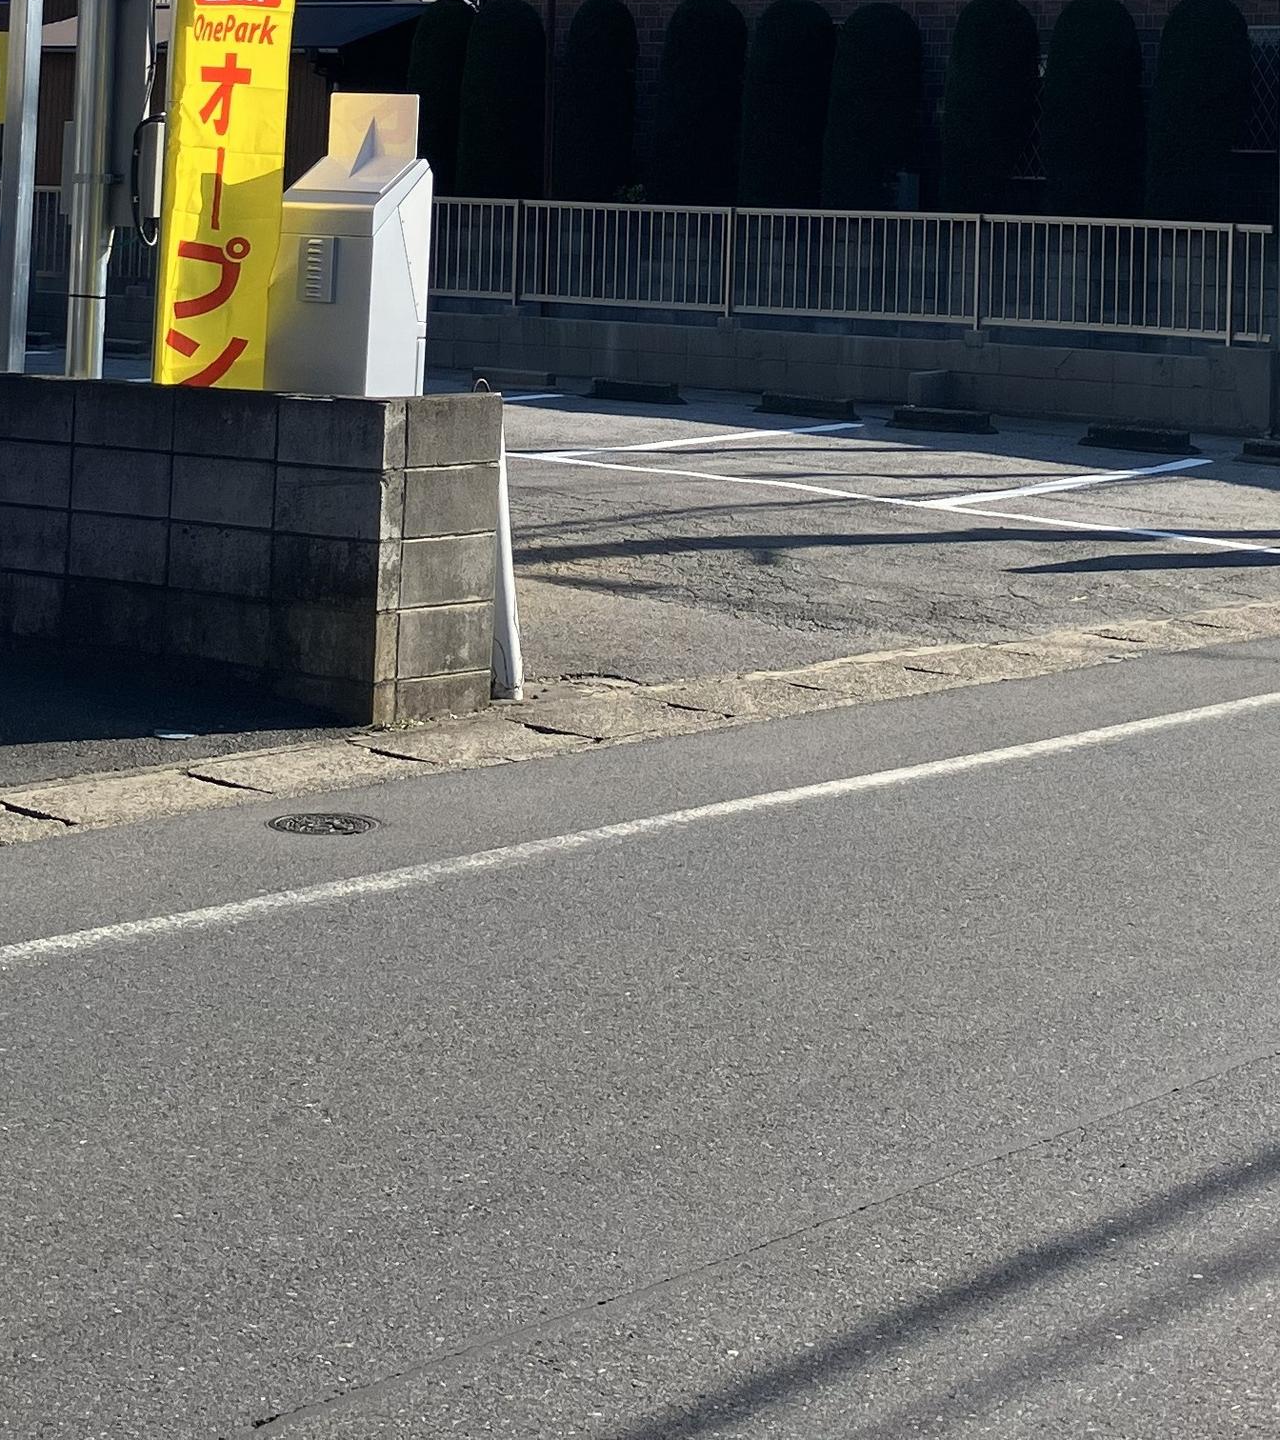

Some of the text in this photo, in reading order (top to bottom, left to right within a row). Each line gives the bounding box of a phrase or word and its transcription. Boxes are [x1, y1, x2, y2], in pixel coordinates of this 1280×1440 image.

[194, 14, 279, 45] OnePark
[166, 53, 252, 387] オープン
